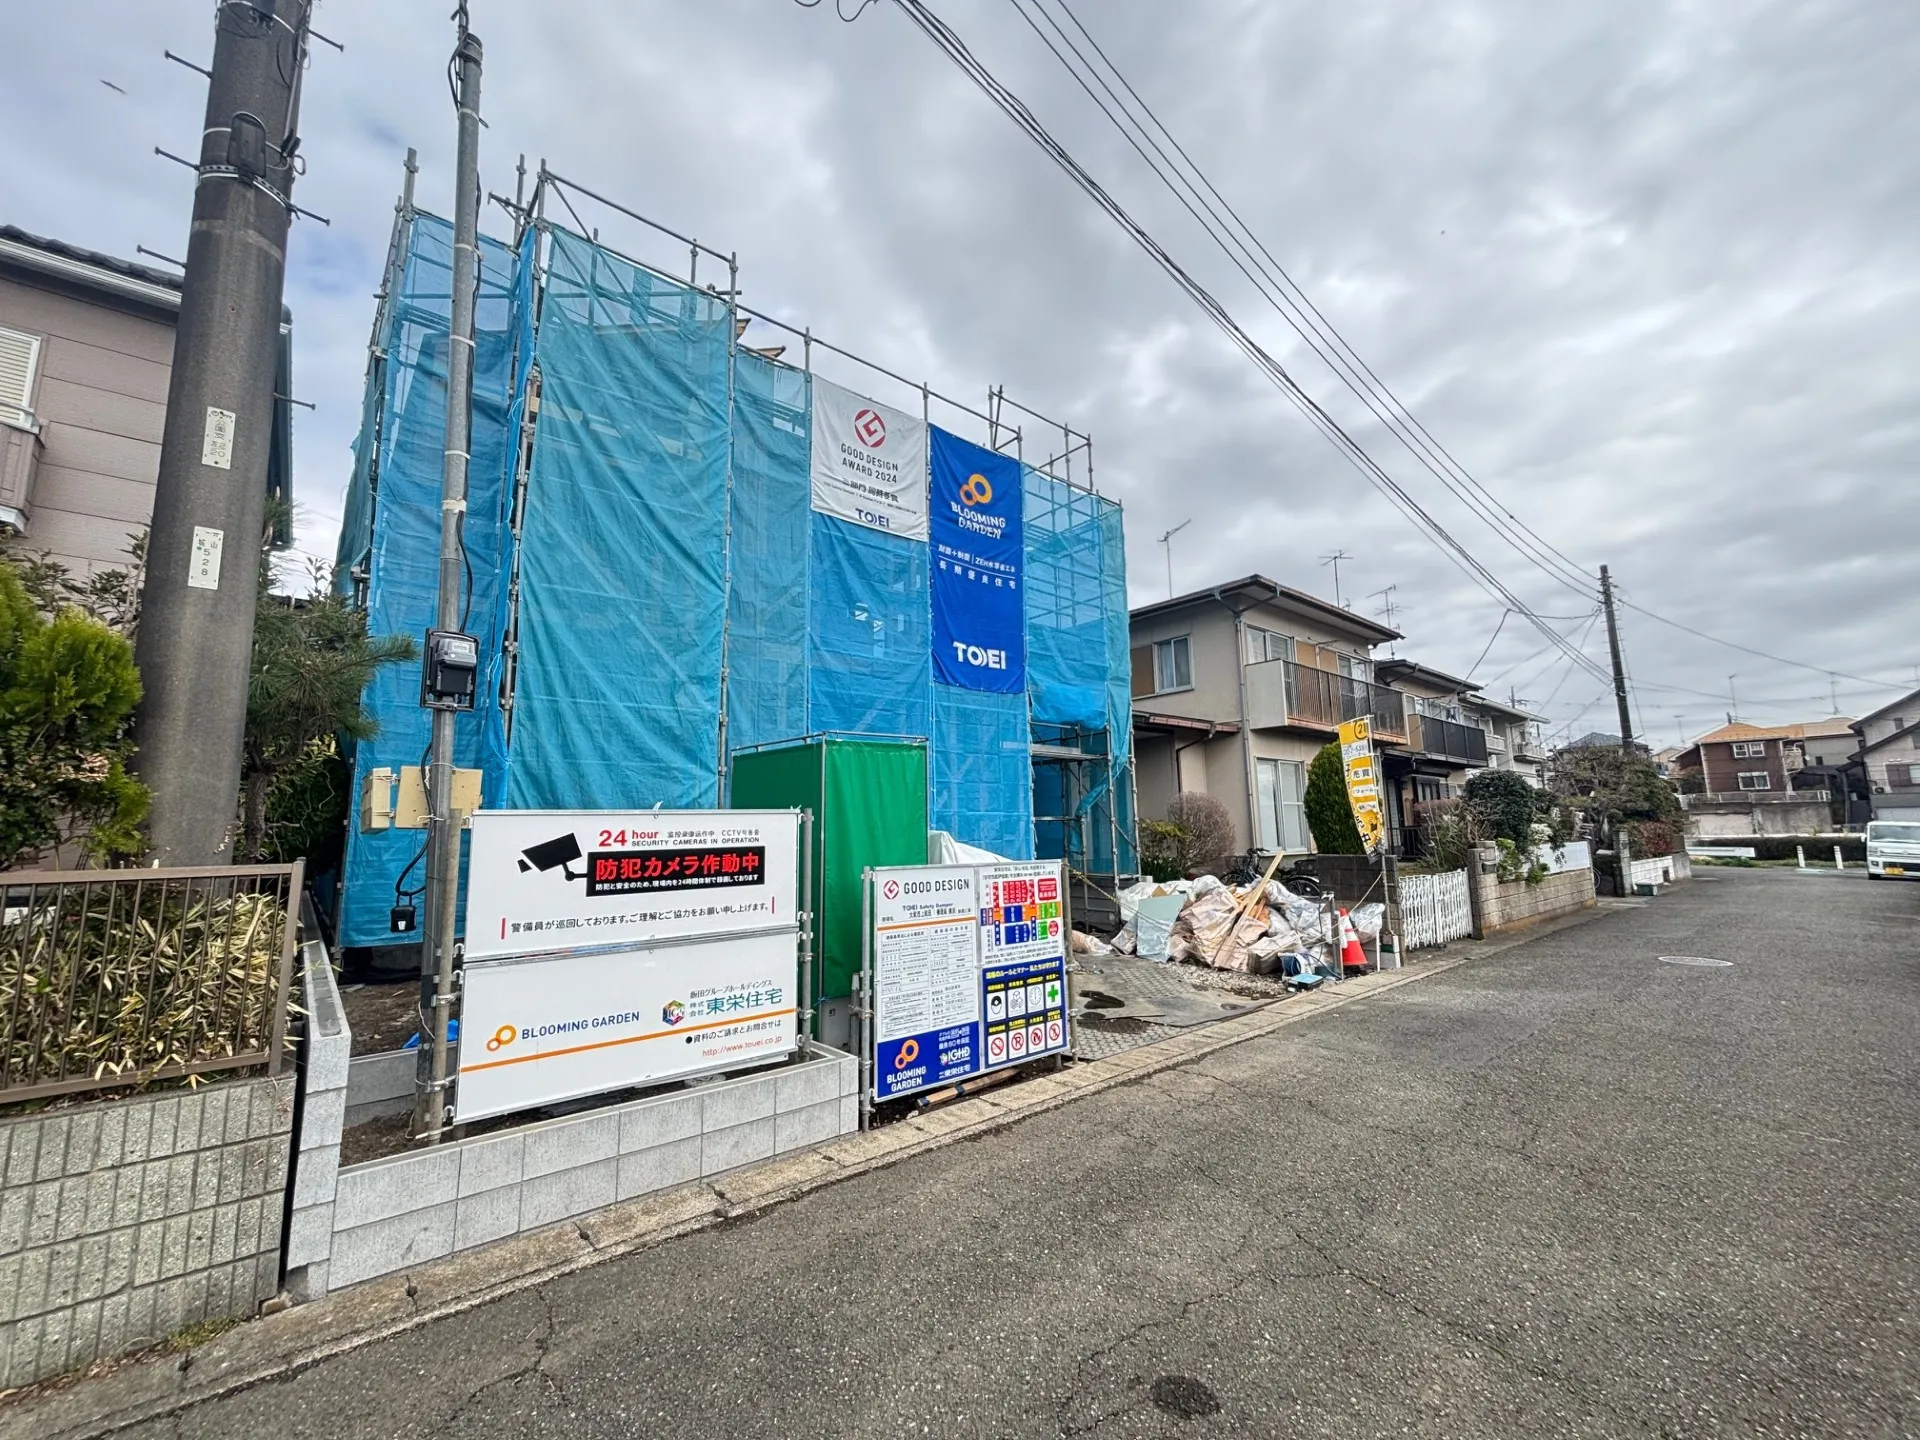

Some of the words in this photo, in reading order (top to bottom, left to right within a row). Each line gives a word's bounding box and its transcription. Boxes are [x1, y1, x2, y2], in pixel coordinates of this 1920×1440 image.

[841, 443, 864, 461] GOOD
[866, 454, 898, 471] DESIGN
[842, 457, 873, 477] AWARD
[875, 470, 897, 484] 2024
[950, 501, 1006, 528] BLOOMING
[958, 516, 1002, 540] GARDEN
[598, 829, 628, 847] 24
[631, 830, 660, 840] hour
[631, 839, 669, 847] SECURITY
[672, 838, 708, 846] CAMERAS
[595, 852, 759, 881] 防犯カメラ作動中
[903, 881, 932, 894] GOOD
[934, 879, 969, 892] DESIGN
[690, 980, 773, 999] 飯田グループホールディングス
[706, 988, 783, 1015] 東栄住宅
[521, 1019, 589, 1040] BLOOMING
[591, 1011, 640, 1028] GARDEN
[702, 1035, 782, 1057] http://www.touei.co.jp
[886, 1065, 927, 1084] BLOOMING
[891, 1076, 923, 1092] GARDEN
